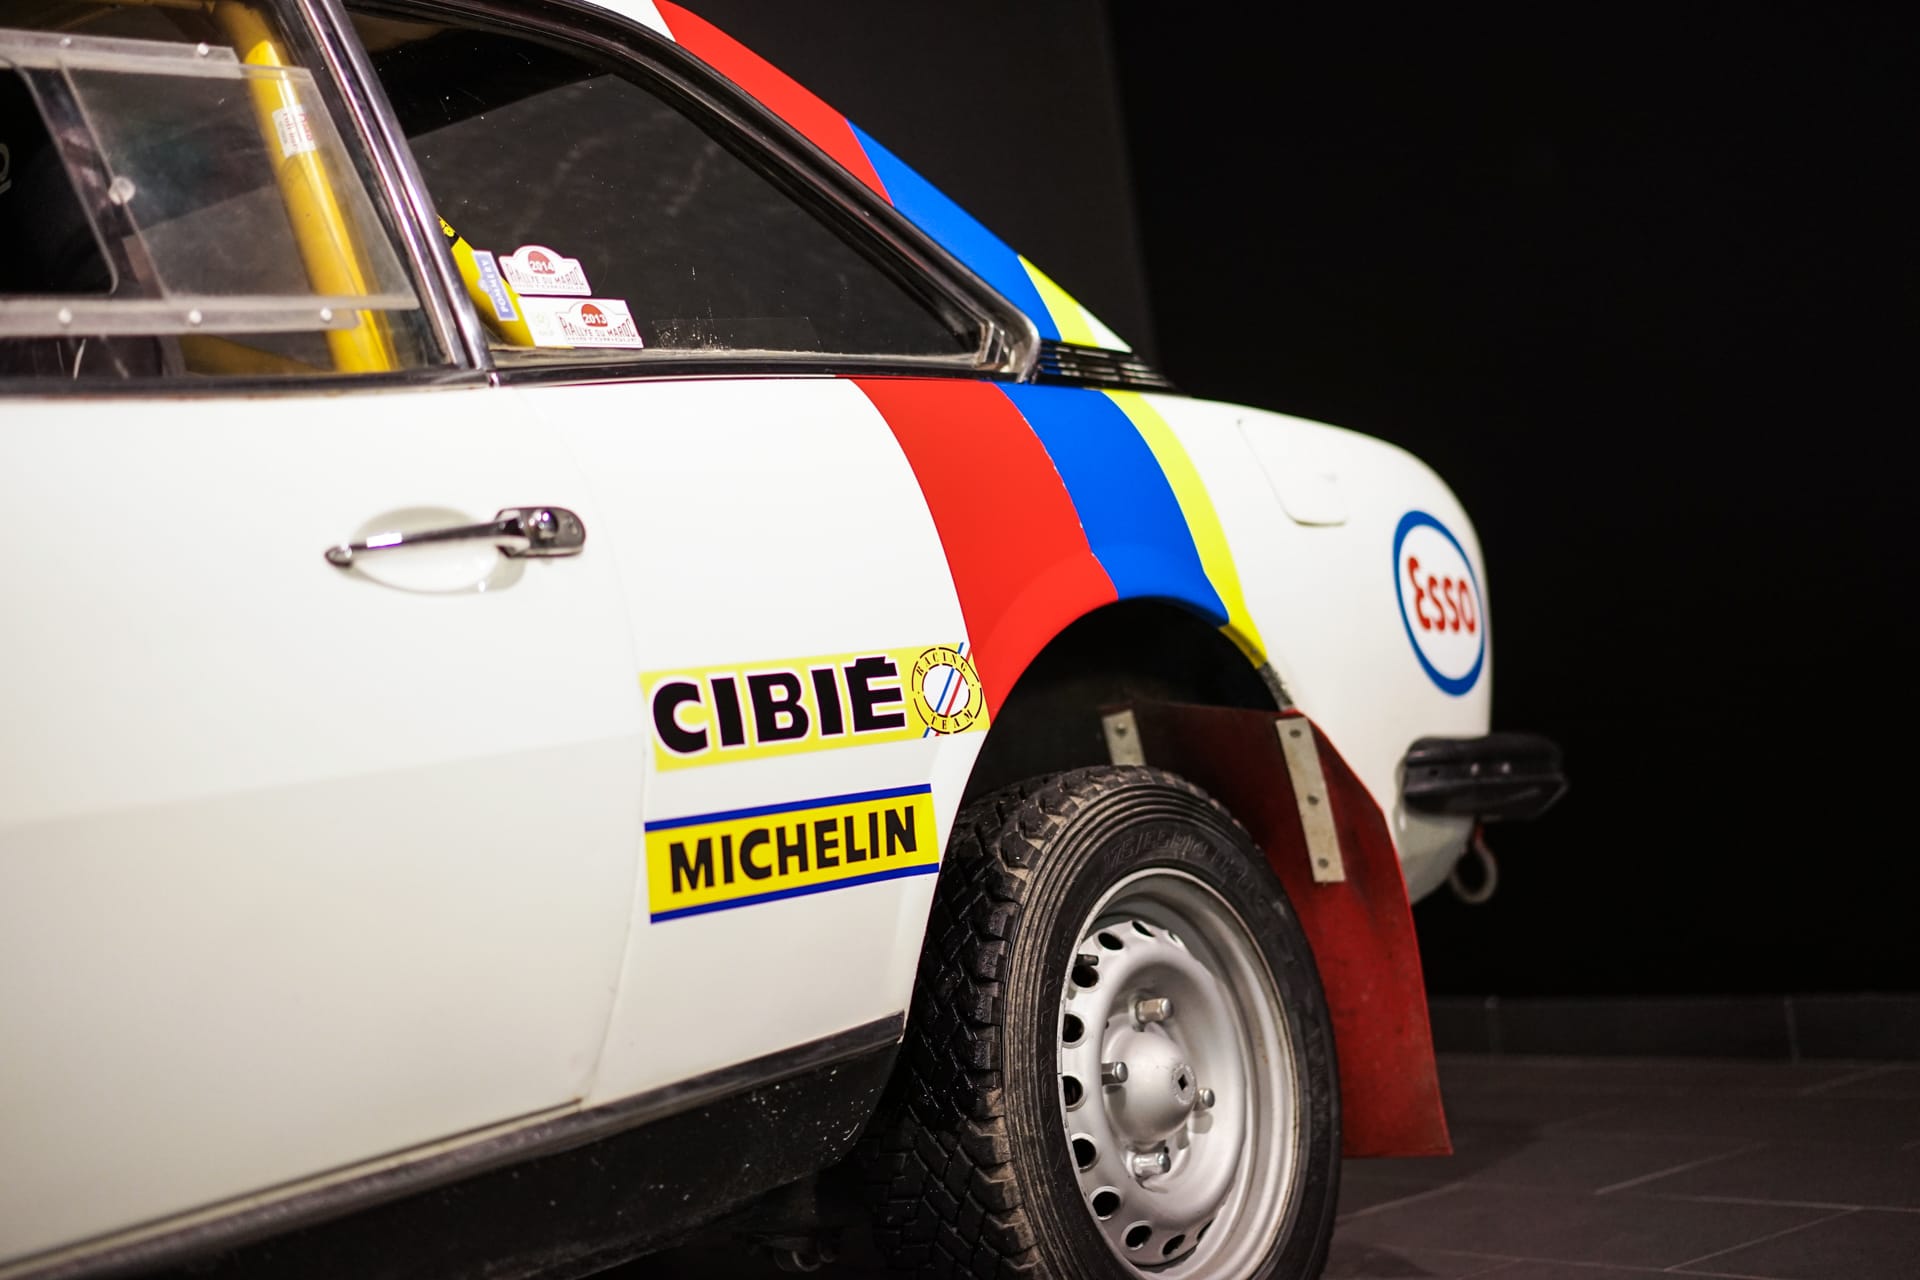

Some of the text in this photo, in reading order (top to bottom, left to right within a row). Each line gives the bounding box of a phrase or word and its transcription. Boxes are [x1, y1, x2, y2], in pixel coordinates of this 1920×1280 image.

[505, 263, 584, 286] RALLYE DU MAROC
[529, 260, 554, 271] 2014
[481, 260, 508, 313] POMMERY
[559, 316, 593, 337] RALLYE
[594, 328, 605, 337] DU
[606, 318, 636, 338] MAROC
[583, 313, 608, 325] 2013
[916, 651, 967, 677] RACING
[652, 656, 906, 754] CIBIÉ
[931, 709, 973, 730] TEAM
[669, 805, 917, 894] MICHELIN
